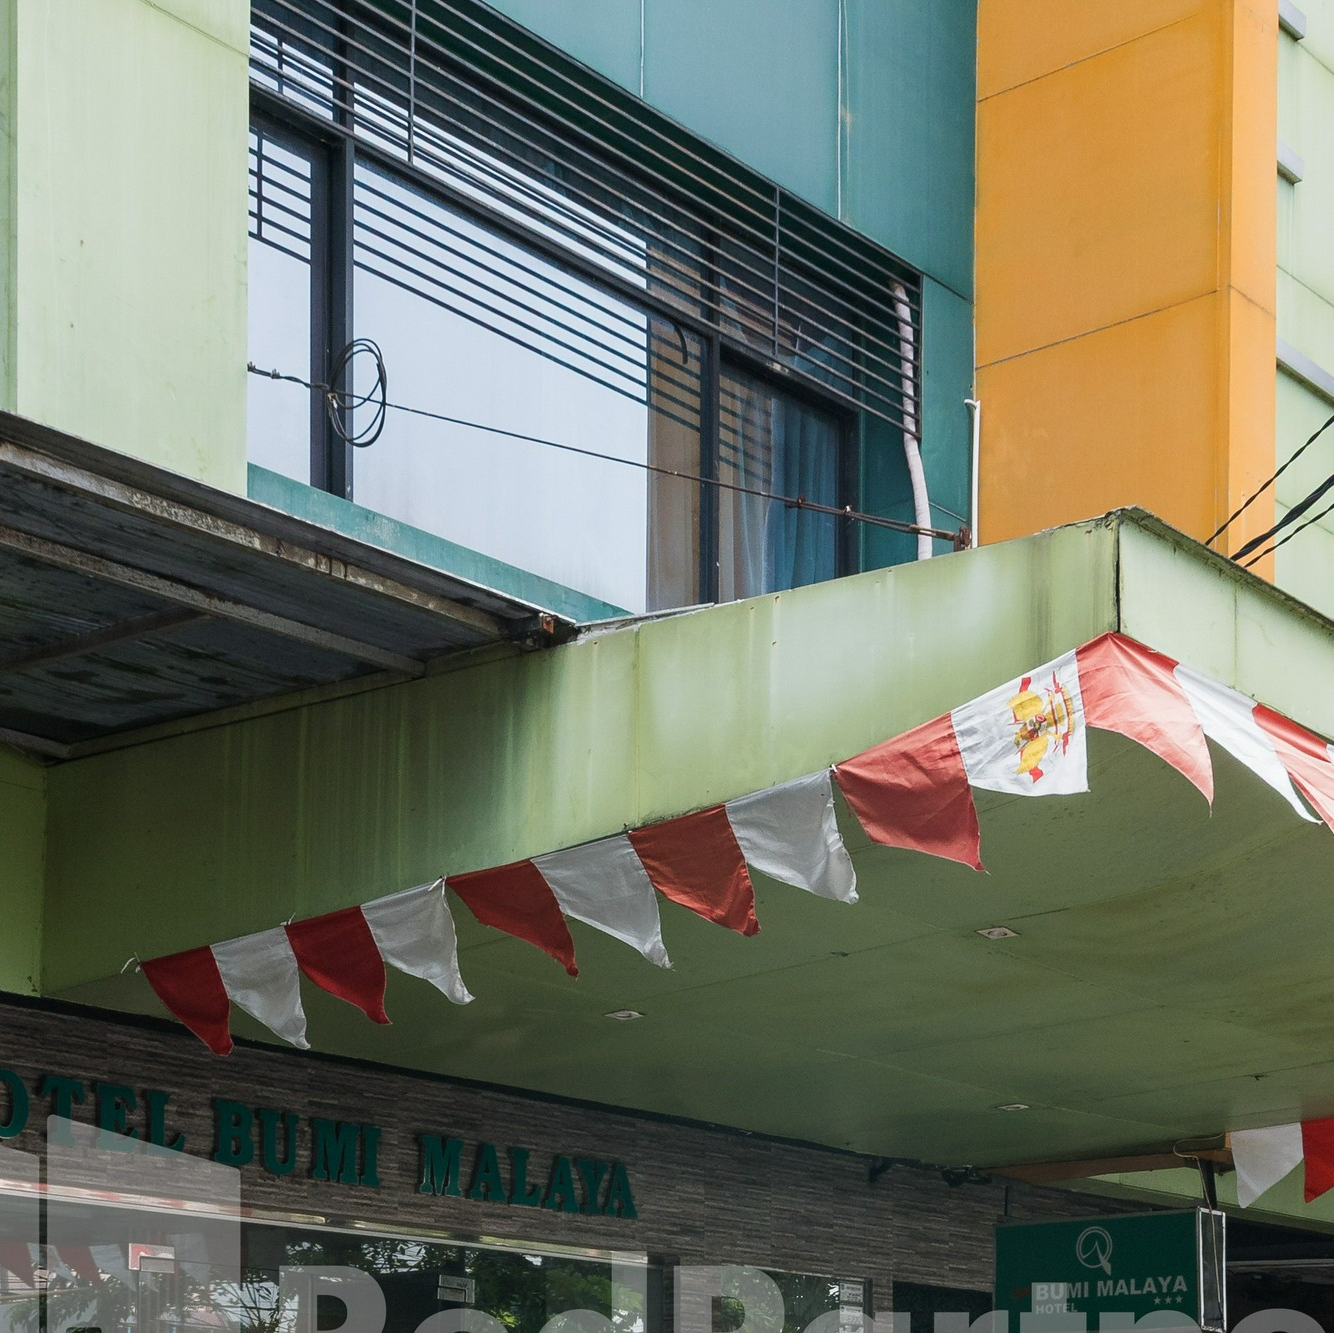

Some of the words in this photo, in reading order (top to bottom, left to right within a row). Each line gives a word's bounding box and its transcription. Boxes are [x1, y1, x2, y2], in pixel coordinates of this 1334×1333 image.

[213, 1097, 383, 1188] BUMI
[417, 1133, 640, 1221] MALAYA
[1035, 1282, 1089, 1301] BUMI
[1097, 1275, 1188, 1297] MALAYA
[1035, 1303, 1078, 1315] HOTEL
